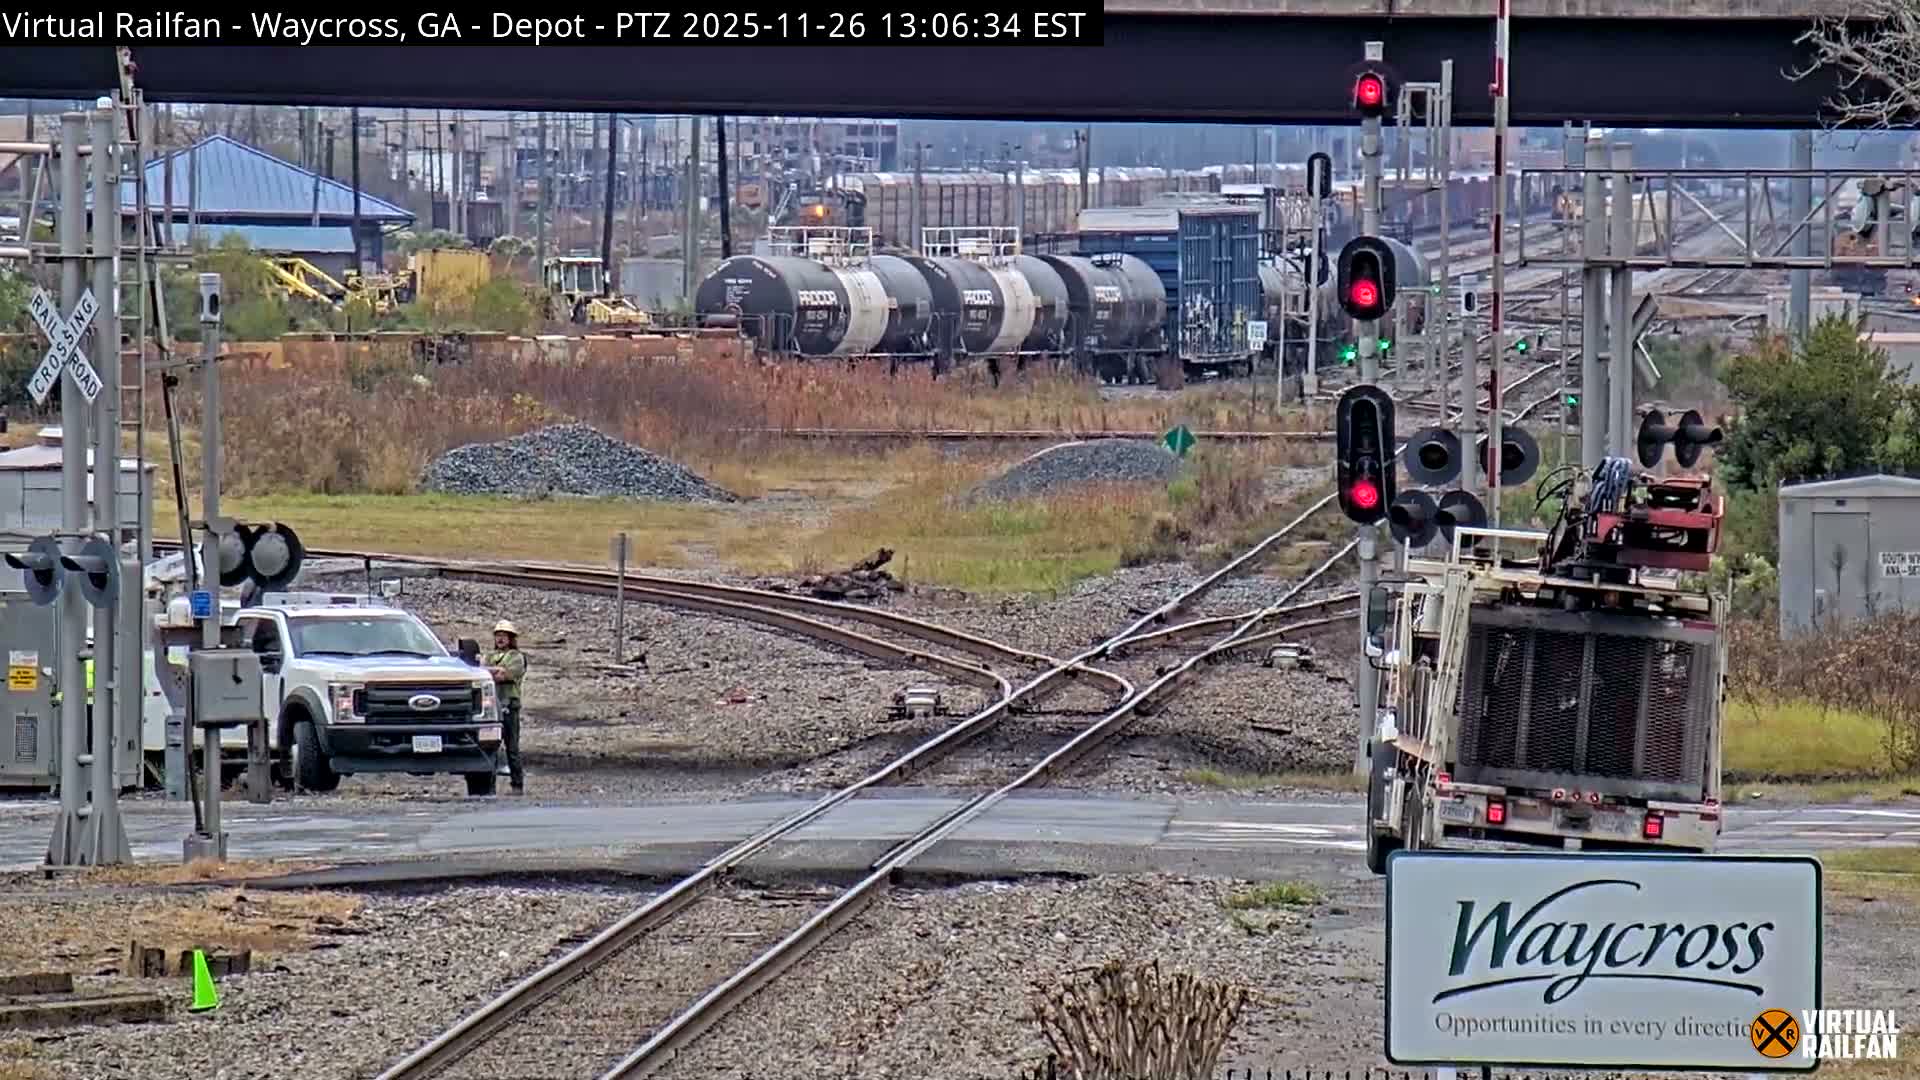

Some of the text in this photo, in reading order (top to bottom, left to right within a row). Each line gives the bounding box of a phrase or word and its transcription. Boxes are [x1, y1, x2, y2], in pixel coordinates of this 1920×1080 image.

[34, 298, 92, 393] CROSSING
[799, 290, 838, 306] PROCOR
[32, 295, 97, 397] RAIL ROAD
[1448, 879, 1775, 1004] Waycross
[1435, 1011, 1752, 1041] Opportunities in every directio
